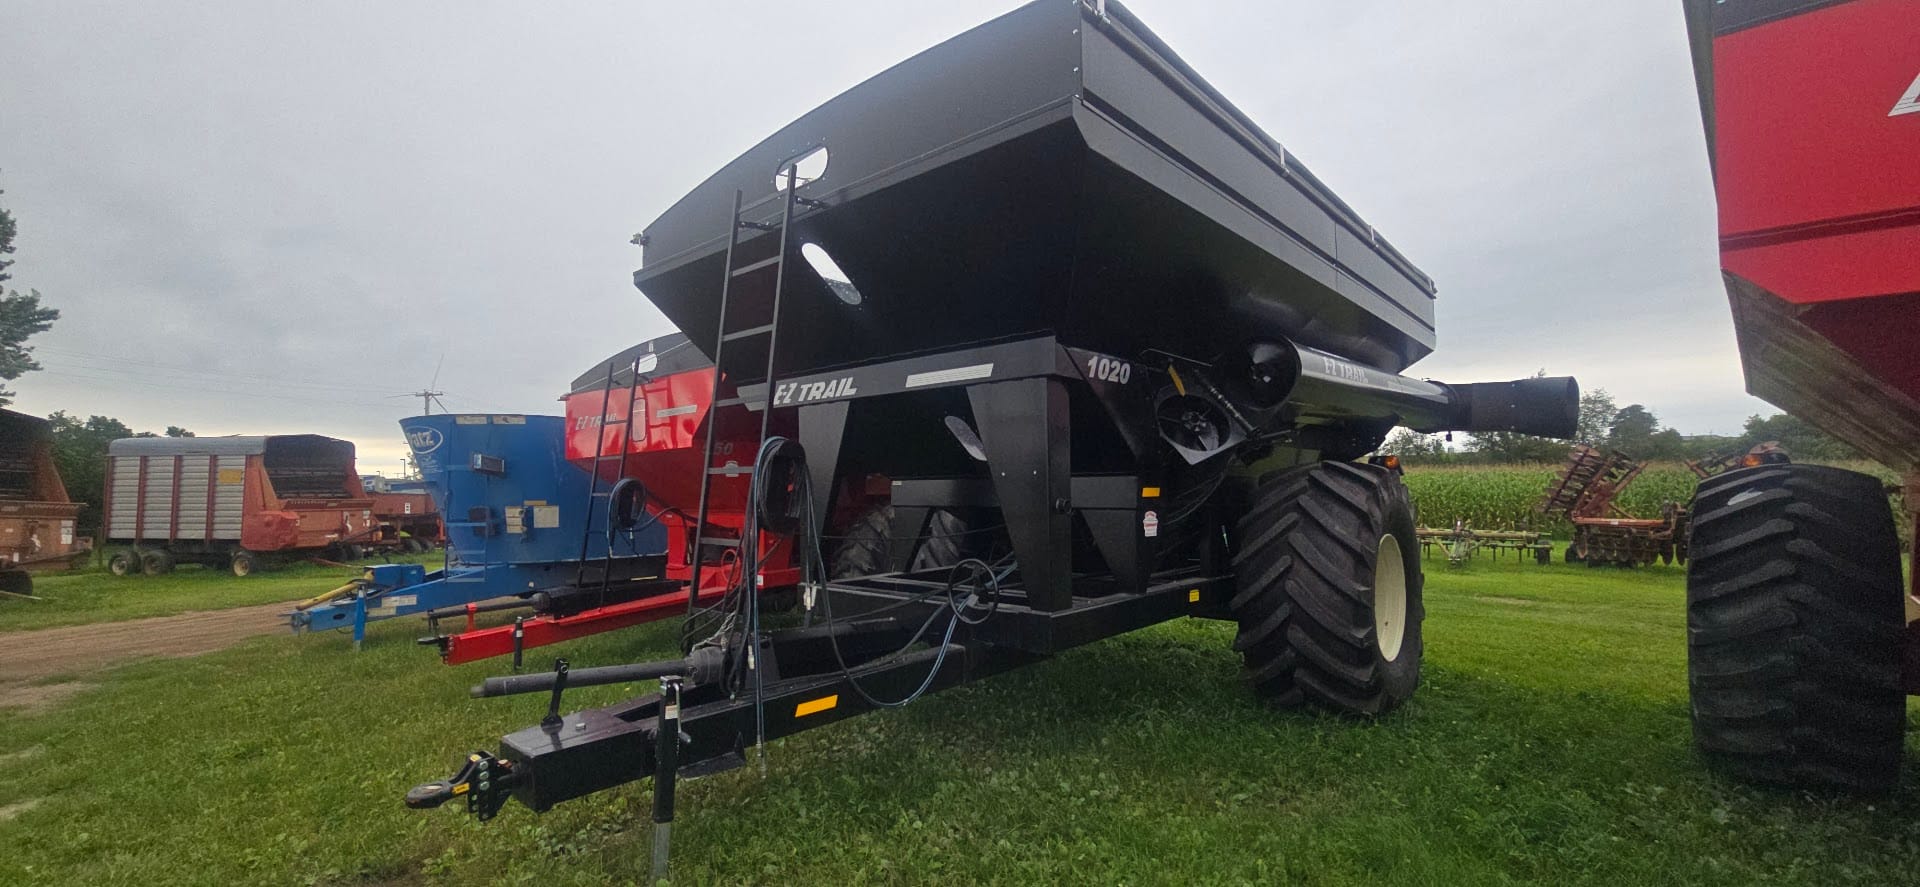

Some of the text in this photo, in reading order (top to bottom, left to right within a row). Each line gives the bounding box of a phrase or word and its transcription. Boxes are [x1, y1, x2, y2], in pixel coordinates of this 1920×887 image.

[1088, 355, 1131, 385] 1020
[1337, 363, 1369, 384] TRAIL
[773, 377, 858, 406] E-Z TRAIL
